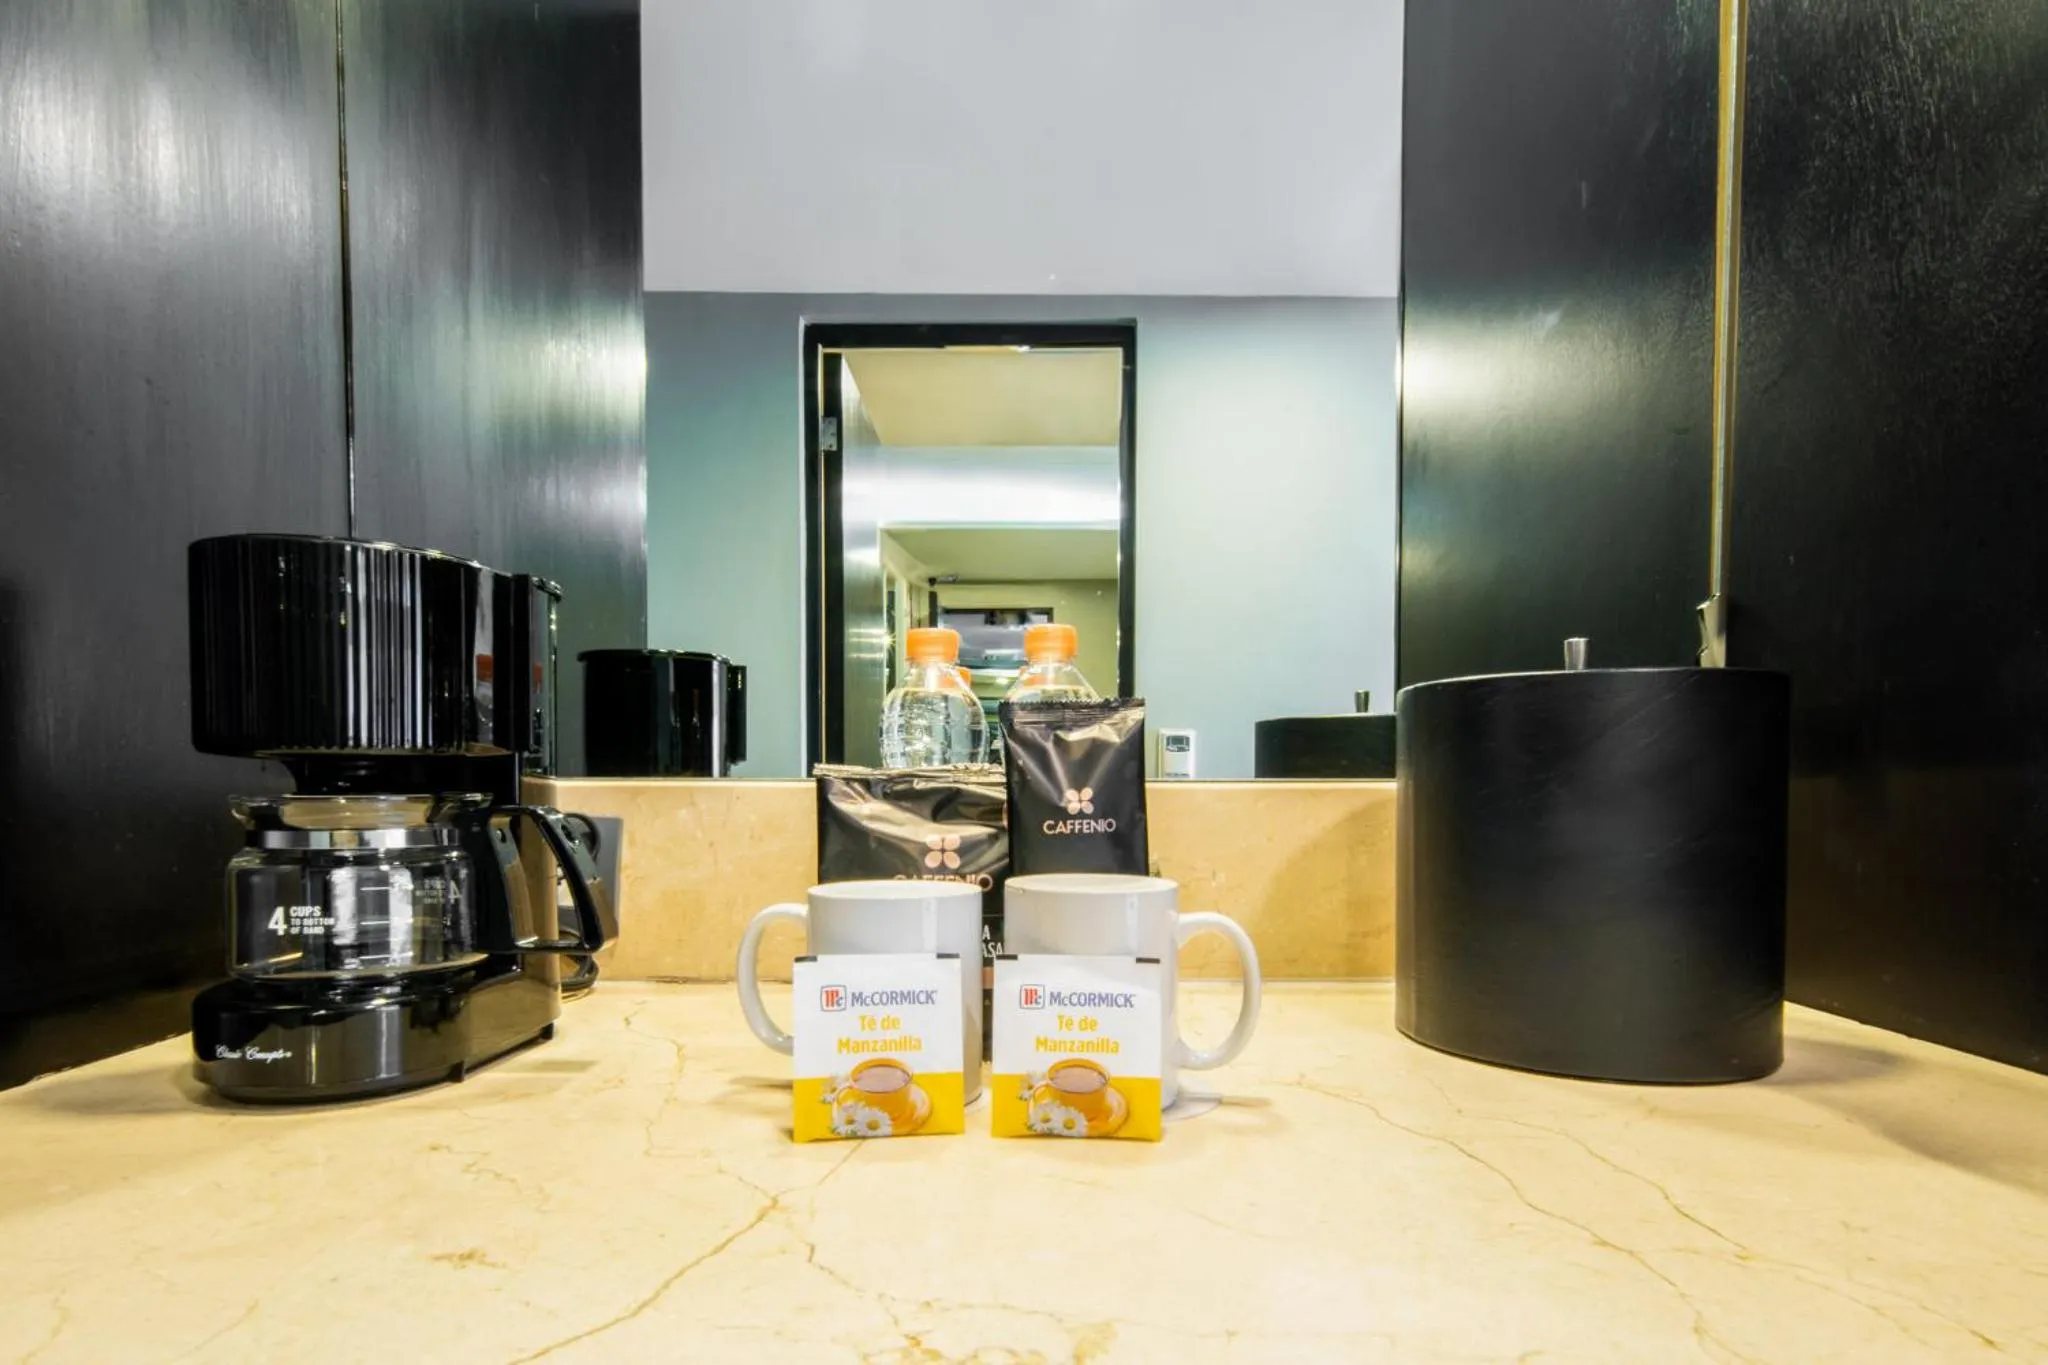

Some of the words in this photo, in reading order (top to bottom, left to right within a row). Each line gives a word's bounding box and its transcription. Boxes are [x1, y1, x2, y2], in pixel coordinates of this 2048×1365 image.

[1042, 818, 1117, 835] CAFFENIO
[267, 905, 288, 936] 4
[289, 905, 322, 917] CUPS
[981, 941, 1004, 958] ASA
[850, 989, 936, 1007] McCORMICK
[1049, 991, 1135, 1008] McCORMICK
[880, 1014, 901, 1032] de
[1078, 1014, 1098, 1032] de
[837, 1035, 923, 1055] Manzanilla
[1035, 1035, 1120, 1055] Manzanilla
